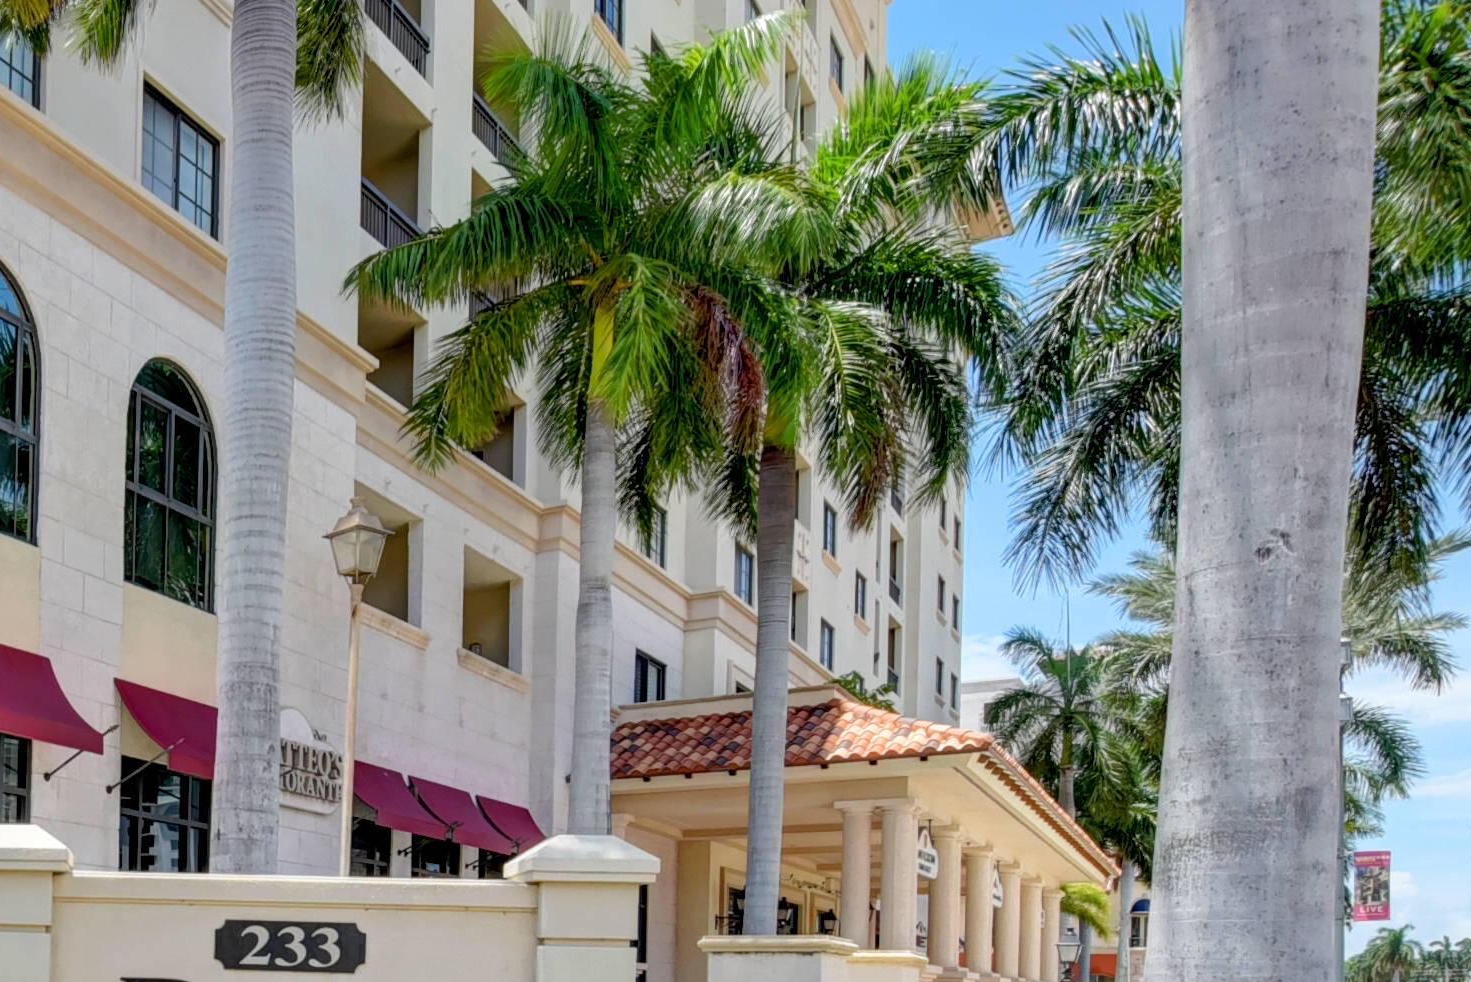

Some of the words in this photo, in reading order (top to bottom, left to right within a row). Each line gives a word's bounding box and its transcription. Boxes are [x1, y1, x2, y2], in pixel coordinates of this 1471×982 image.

[280, 738, 342, 779] TTEO'S
[1358, 905, 1384, 913] LIVE
[238, 925, 342, 969] 233
